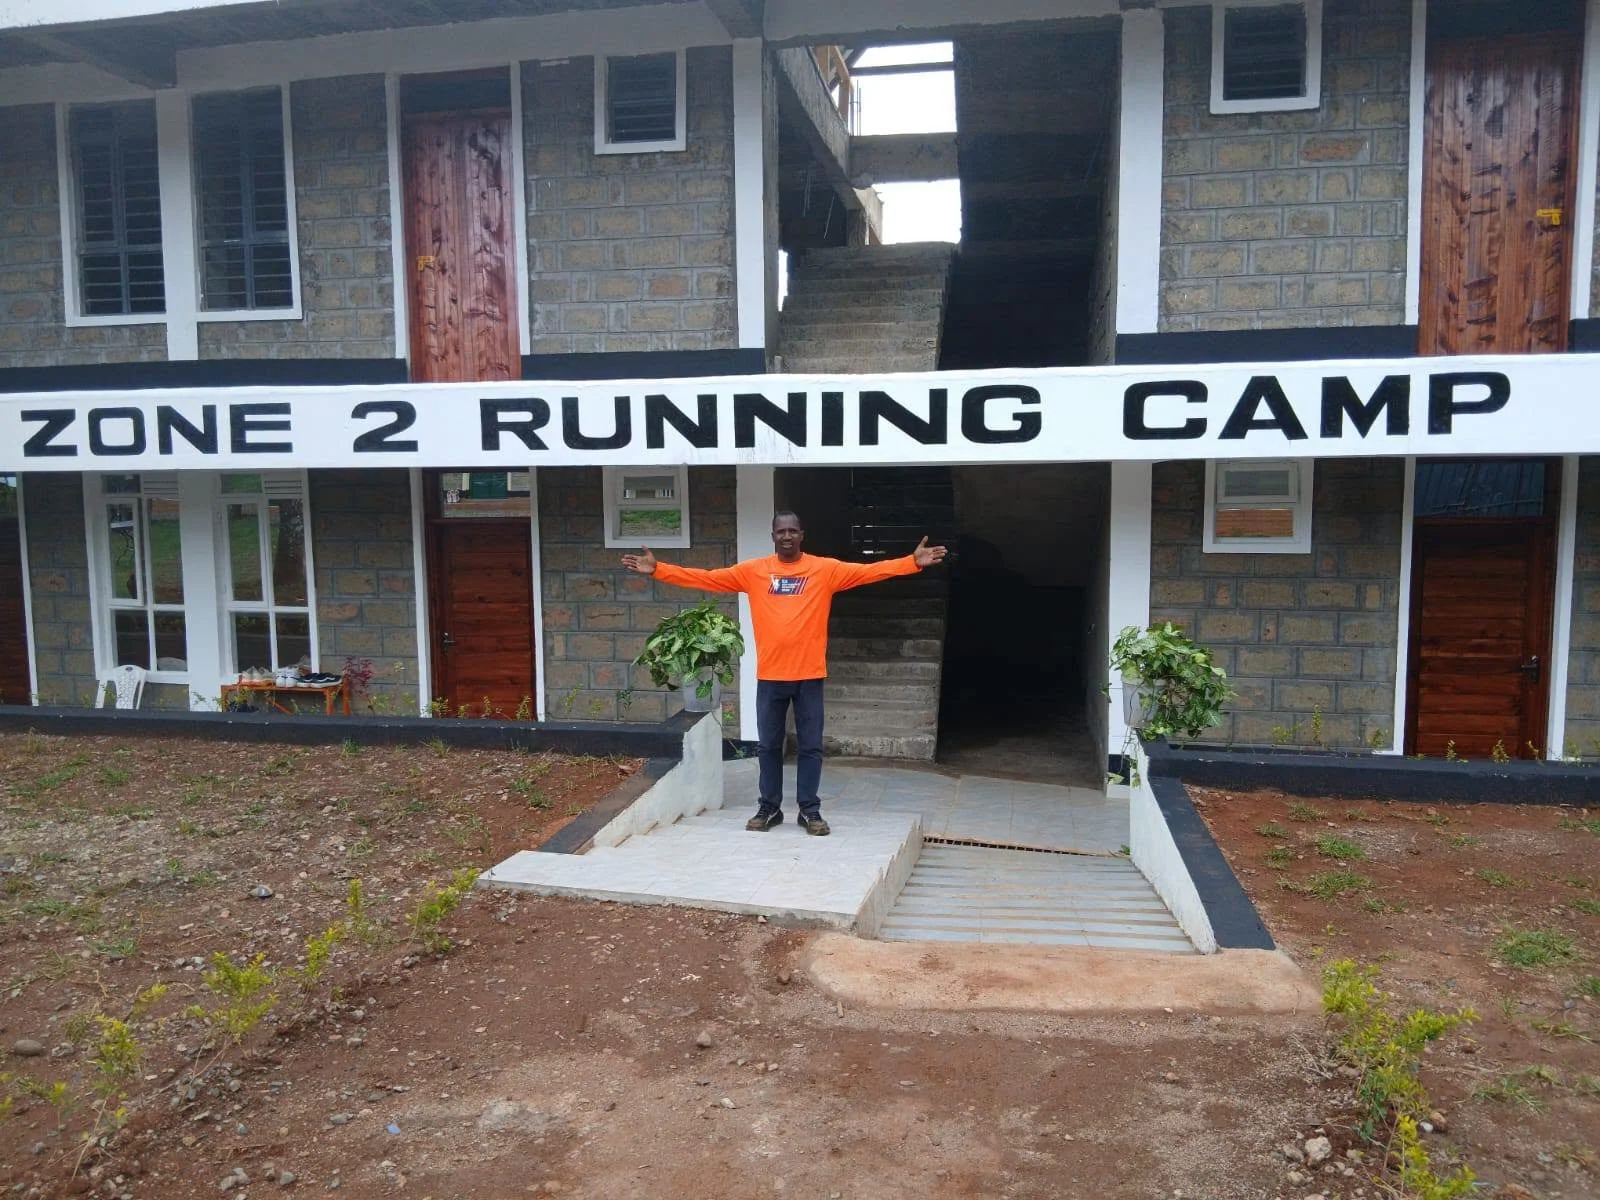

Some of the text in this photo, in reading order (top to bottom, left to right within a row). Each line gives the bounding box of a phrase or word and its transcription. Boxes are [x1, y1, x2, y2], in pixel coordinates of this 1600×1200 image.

[20, 372, 1512, 457] ZONE 2 RUNNING CAMP
